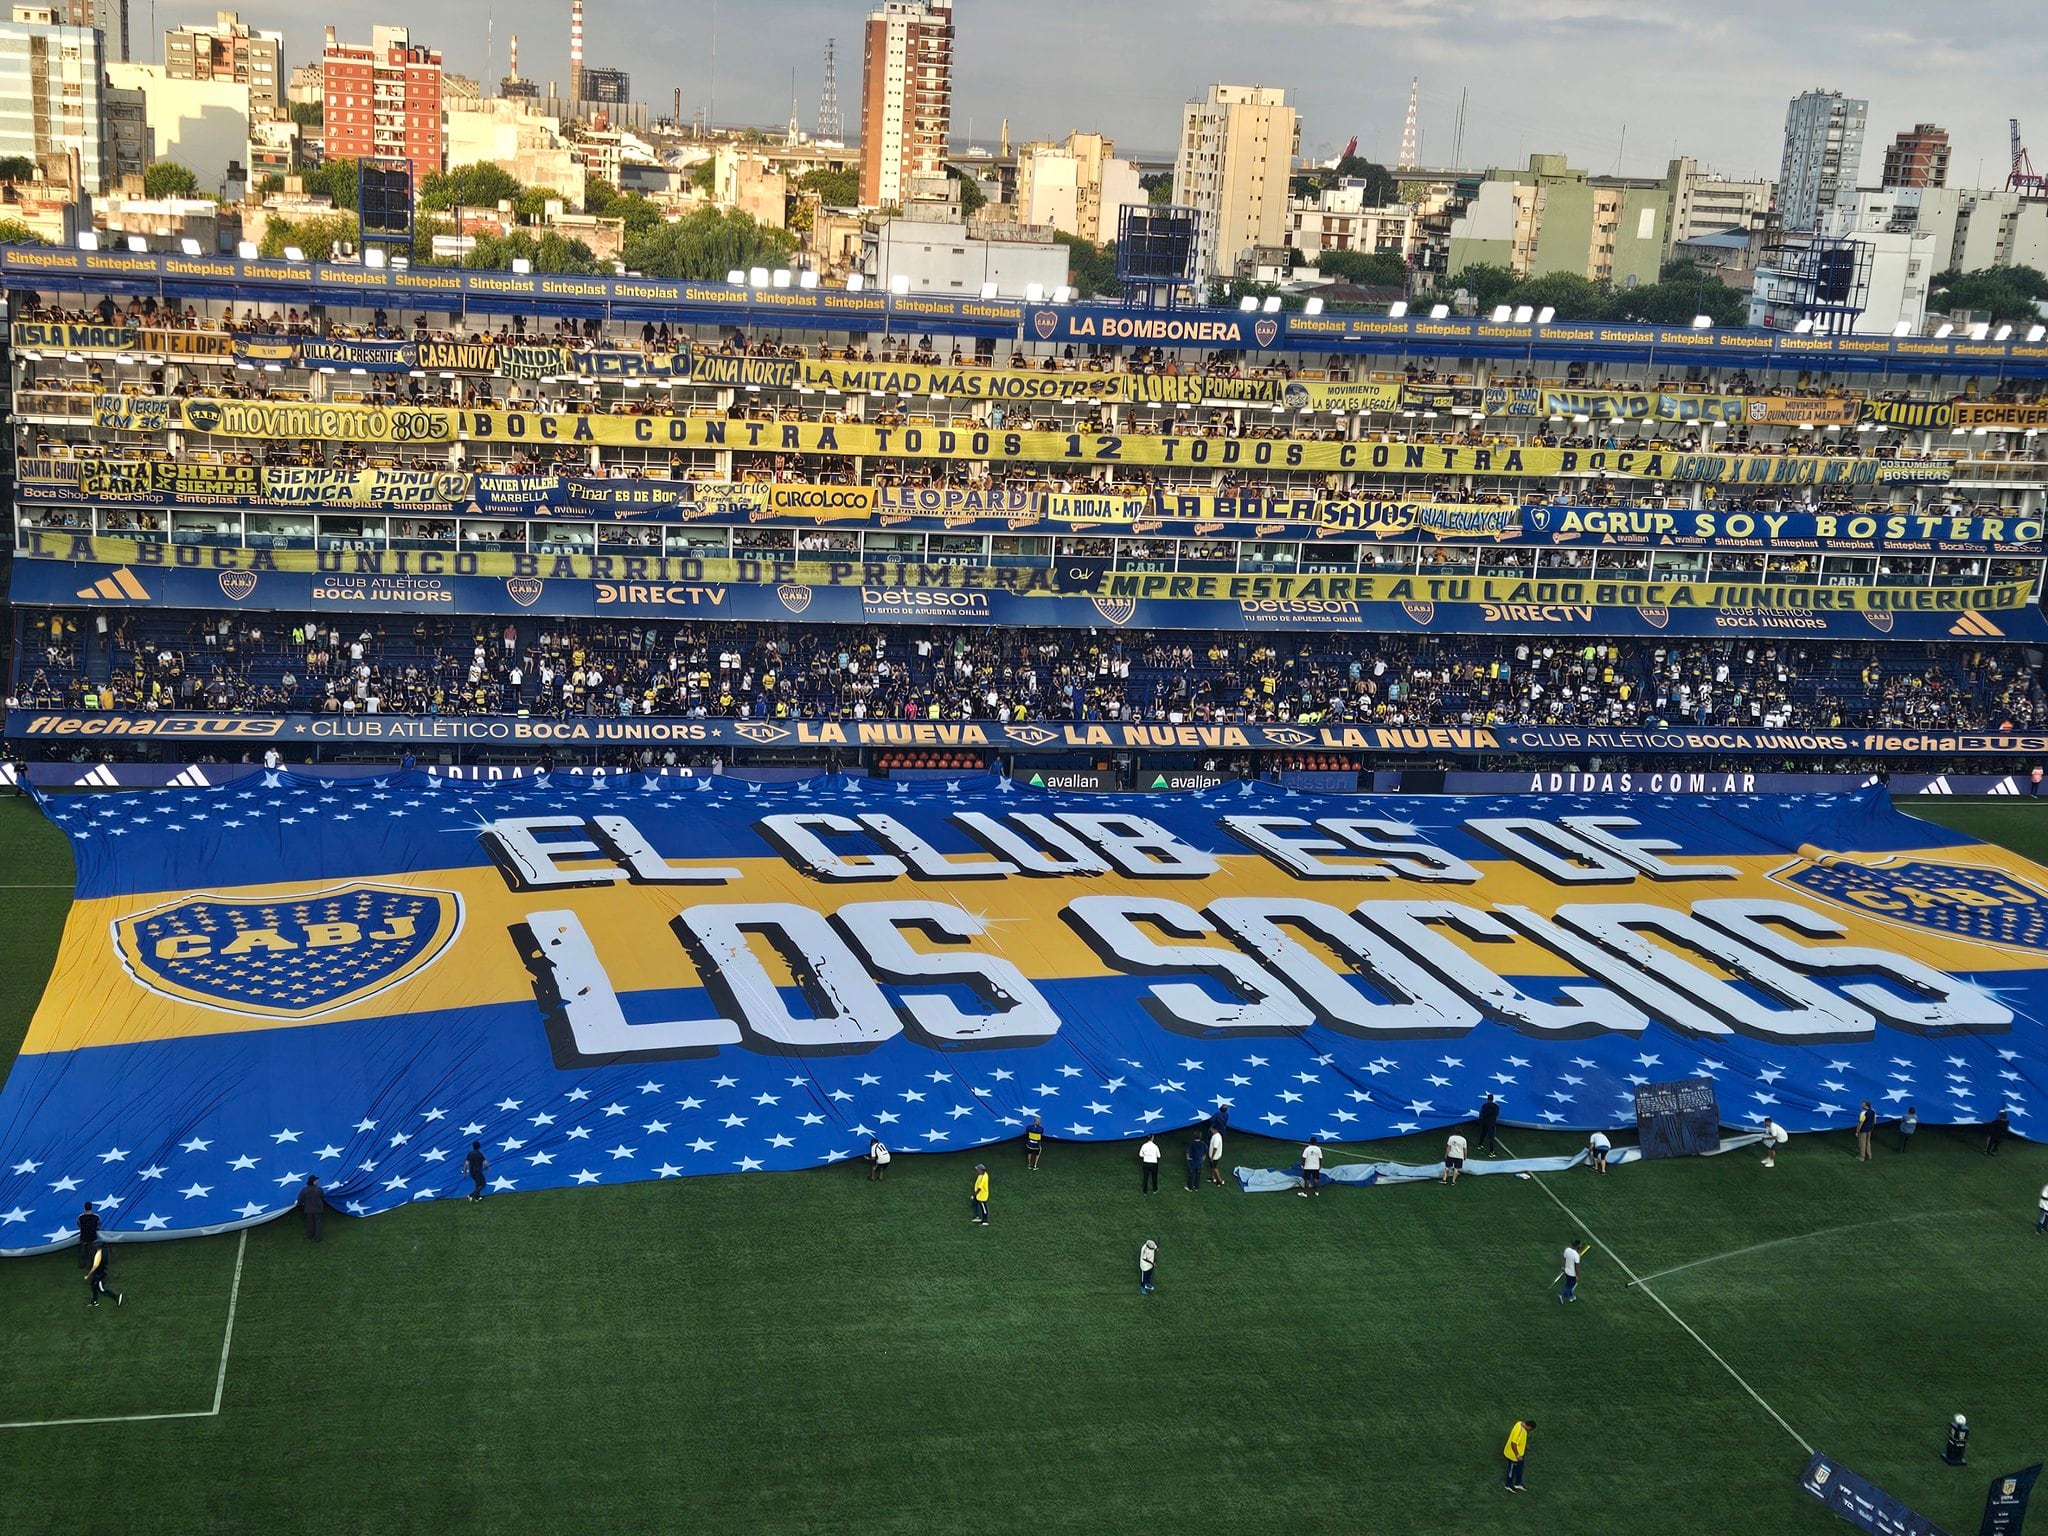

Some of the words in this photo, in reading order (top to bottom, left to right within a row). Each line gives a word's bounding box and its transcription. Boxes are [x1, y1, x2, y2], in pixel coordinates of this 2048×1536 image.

[7, 252, 78, 268] Sinteplast
[86, 256, 157, 272] Sinteplast
[166, 261, 236, 277] Sinteplast
[243, 266, 312, 281] Sinteplast
[320, 270, 387, 286] Sinteplast
[395, 275, 461, 289] Sinteplast
[469, 278, 534, 293] Sinteplast
[542, 281, 606, 296] Sinteplast
[614, 284, 678, 300] Sinteplast
[685, 289, 747, 304] Sinteplast
[18, 324, 65, 347] ISLA
[1069, 317, 1096, 336] LA
[1101, 318, 1241, 341] BOMBONERA
[1289, 318, 1346, 333] Sinteplast
[1352, 321, 1409, 336] Sinteplast
[1415, 323, 1471, 339] Sinteplast
[303, 344, 331, 360] VILLA
[332, 343, 348, 361] 21
[350, 349, 398, 364] PRESENTE
[419, 343, 495, 369] CASANOVA
[692, 356, 738, 383] ZONA
[744, 357, 793, 387] NORTE
[805, 363, 835, 388] LA
[842, 370, 921, 393] MITAD
[929, 371, 982, 396] MÁS
[1130, 374, 1201, 403] FLORES
[1204, 377, 1277, 401] POMPEYA
[1327, 385, 1380, 395] MOVIMIENTO
[127, 399, 168, 414] VERDE
[1312, 398, 1323, 410] LA
[1325, 398, 1346, 411] BOCA
[1349, 398, 1359, 410] ES
[1550, 393, 1651, 418] NUEVO
[1654, 394, 1744, 422] BOCA
[1766, 408, 1812, 421] QUINQUELA
[1785, 401, 1827, 410] MOVIMIENTO
[99, 413, 131, 429] KM
[138, 416, 162, 430] 36
[221, 403, 388, 438] movimiento
[391, 410, 450, 442] 805
[474, 413, 594, 441] BOCA
[634, 418, 839, 451] CONTRA
[875, 427, 1022, 456] TODOS
[1064, 434, 1123, 459] 12
[1162, 438, 1303, 466] TODOS
[1339, 445, 1524, 472] CONTRA
[1561, 451, 1663, 477] BOCA
[21, 461, 53, 479] SANTA
[54, 461, 79, 480] CRUZ
[84, 460, 149, 480] SANTA
[157, 463, 255, 481] CHELO
[1729, 458, 1744, 481] X
[1746, 459, 1772, 482] UN
[1773, 459, 1817, 483] BOCA
[1822, 460, 1879, 485] MEJOR
[1880, 459, 1951, 470] COSTUMBRES
[88, 476, 149, 494] CLARA
[479, 477, 519, 493] XAVIER
[1883, 469, 1951, 482] BOSTERAS
[24, 487, 56, 499] Boca
[58, 489, 89, 502] Shop
[155, 478, 171, 491] X
[175, 480, 258, 495] SIEMPRE
[271, 485, 353, 501] NUNCA
[371, 485, 436, 501] SAPO
[442, 476, 465, 497] 12
[567, 482, 612, 500] Pinar
[615, 490, 631, 502] ES
[634, 490, 649, 502] DE
[491, 491, 549, 503] MARBELLA
[774, 489, 868, 509] CIRCOLOCO
[881, 487, 1040, 513] LEOPARDI
[1155, 496, 1201, 518] LA
[1052, 499, 1071, 516] LA
[1072, 499, 1112, 519] RIOJA
[1560, 513, 1674, 533] AGRUP.
[1695, 514, 1790, 538] SOY
[1816, 516, 2042, 541] BOSTERO
[1715, 537, 1764, 547] Sinteplast
[1771, 538, 1819, 549] Sinteplast
[29, 532, 98, 562] LA
[136, 541, 279, 572] BOCA
[315, 550, 478, 576] UNICO
[512, 553, 704, 582] BARRIO
[737, 559, 797, 584] DE
[829, 561, 1055, 592] PRIMERA
[323, 577, 367, 588] CLUB
[312, 588, 367, 601] BOCA
[370, 589, 453, 602] JUNIORS
[594, 583, 726, 606] DIRECTV
[861, 586, 989, 607] betsson
[1229, 577, 1375, 600] ESTARE
[1388, 578, 1414, 600] A
[1428, 579, 1471, 601] TU
[1596, 584, 1698, 607] BOCA
[1706, 586, 1857, 611] JUNIORS
[1867, 586, 2019, 611] QUERIDO
[864, 606, 876, 614] TU
[878, 607, 899, 615] SITIO
[915, 608, 957, 616] APUESTAS
[958, 609, 990, 617] ONLINE
[1478, 603, 1593, 623] DIRECTV
[1715, 617, 1758, 629] BOCA
[1762, 618, 1828, 630] JUNIORS
[311, 721, 383, 737] CLUB
[389, 719, 510, 739] ATLÉTICO
[514, 723, 590, 739] BOCA
[595, 723, 706, 741] JUNIORS
[751, 727, 774, 738] LN
[797, 723, 848, 743] LA
[858, 723, 990, 744] NUEVA
[1064, 725, 1113, 746] LA
[1121, 726, 1250, 746] NUEVA
[1319, 728, 1367, 748] LA
[1375, 728, 1500, 749] NUEVA
[1522, 733, 1582, 748] CLUB
[1587, 731, 1685, 749] ATLÉTICO
[1687, 734, 1751, 749] BOCA
[1755, 735, 1847, 750] JUNIORS
[1047, 774, 1099, 789] avalian
[1170, 775, 1221, 789] avalian
[1530, 773, 1756, 793] ADIDAS.COM.AR
[492, 815, 743, 888] EL
[753, 812, 1220, 883] CLUB
[1218, 815, 1485, 885] ES
[1462, 815, 1744, 884] DE
[1846, 884, 2038, 910] CABJ
[155, 914, 417, 961] CABJ
[516, 900, 1062, 1060] LOS
[1062, 895, 2015, 1040] SOCIOS
